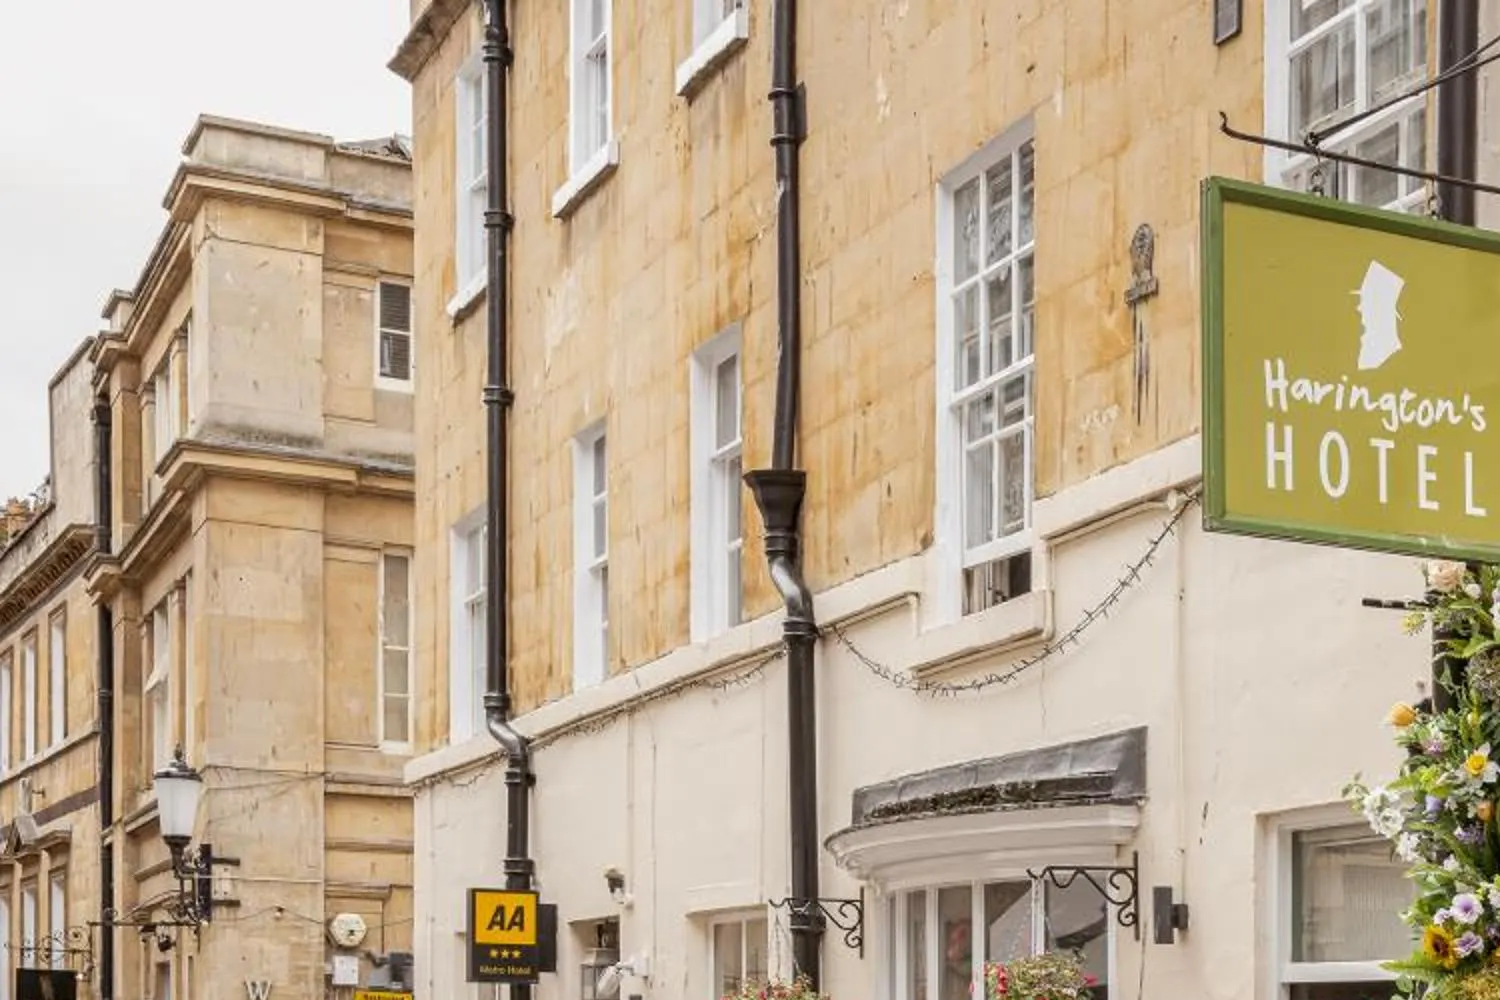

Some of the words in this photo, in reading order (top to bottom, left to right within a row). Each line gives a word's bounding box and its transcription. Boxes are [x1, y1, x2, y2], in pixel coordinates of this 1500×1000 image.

[1263, 357, 1487, 432] Harington's
[1265, 421, 1487, 517] HOTEL
[486, 904, 525, 932] AA
